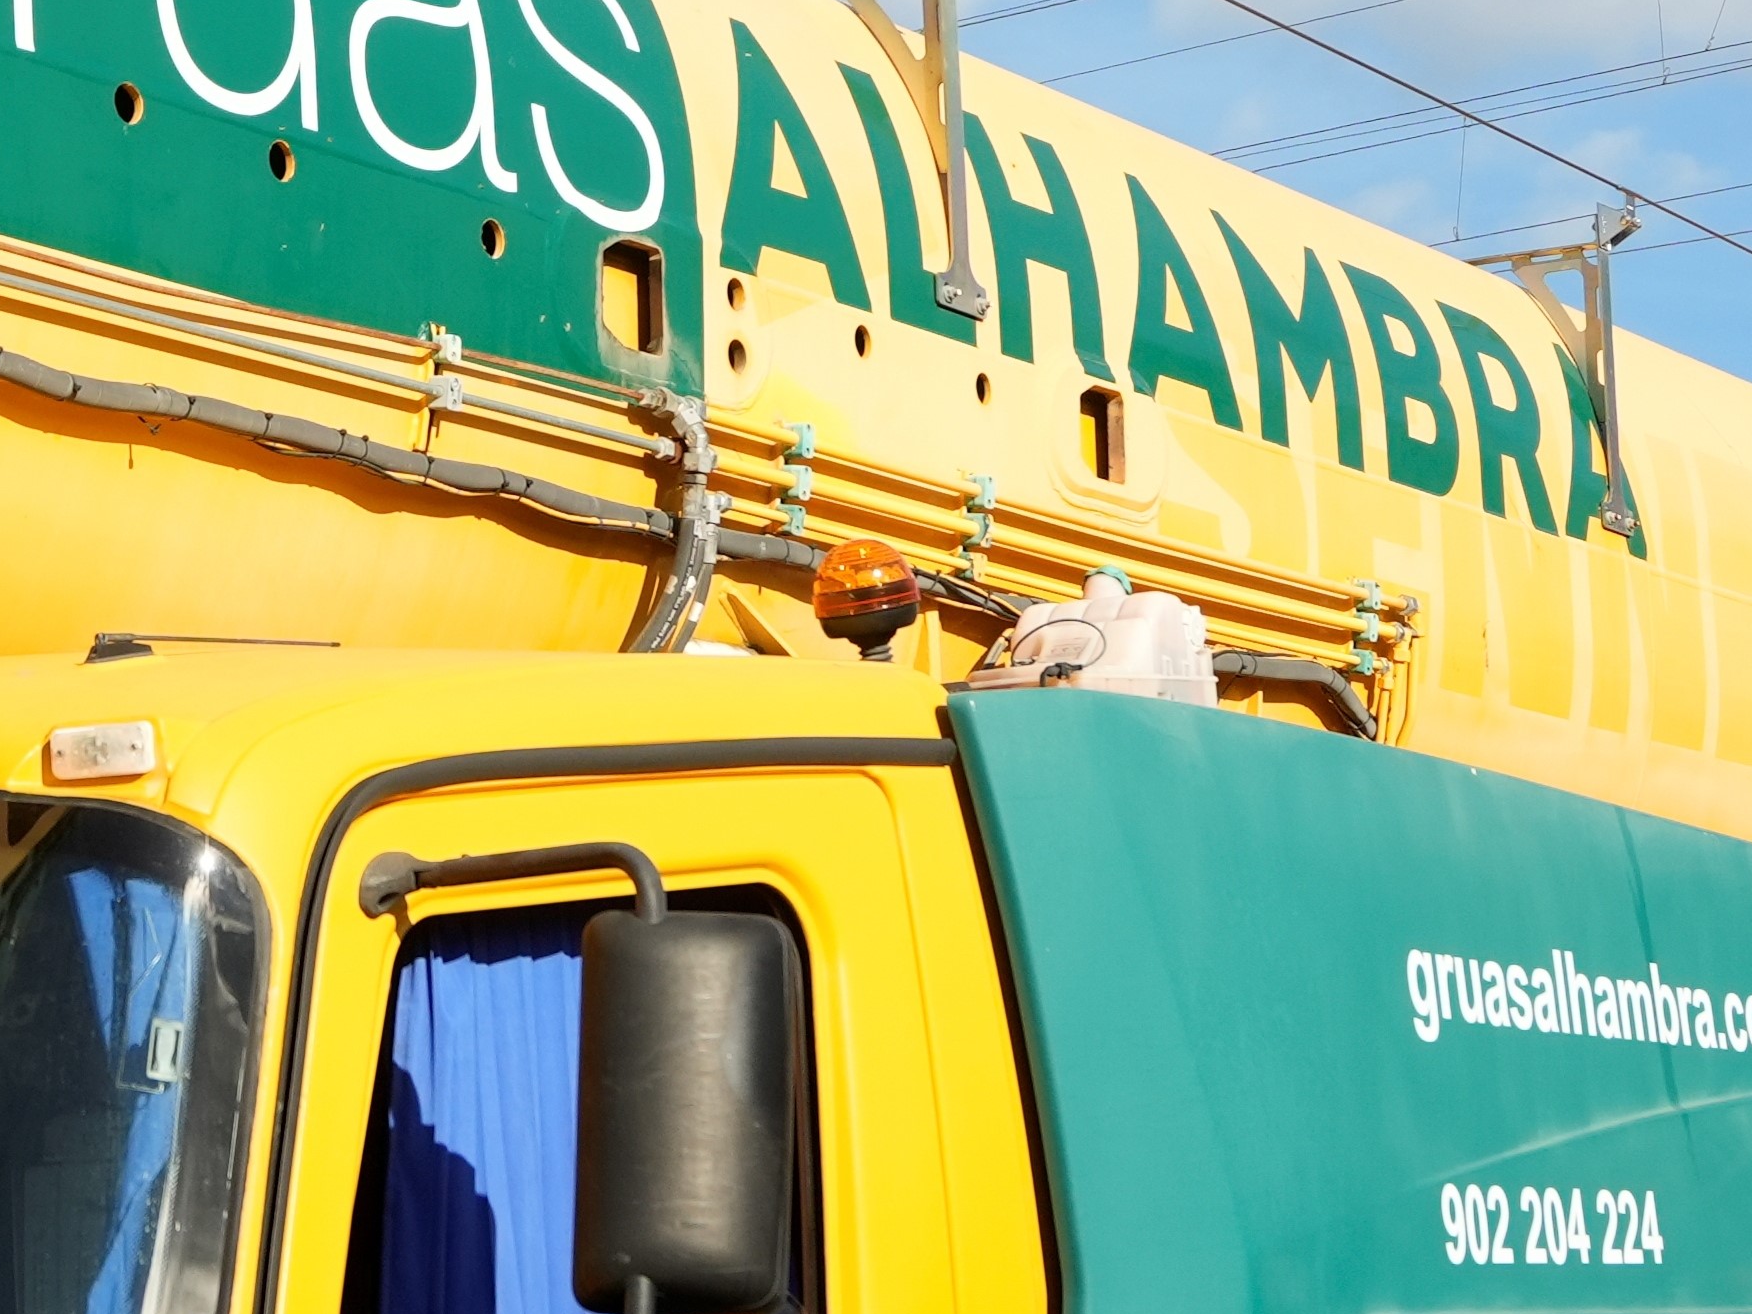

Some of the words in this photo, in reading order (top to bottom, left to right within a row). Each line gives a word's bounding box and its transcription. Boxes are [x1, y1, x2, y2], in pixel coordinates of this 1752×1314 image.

[723, 20, 1648, 561] ALHAMBRA
[1441, 1182, 1514, 1266] 902
[1520, 1185, 1591, 1266] 204
[1596, 1188, 1664, 1265] 224
